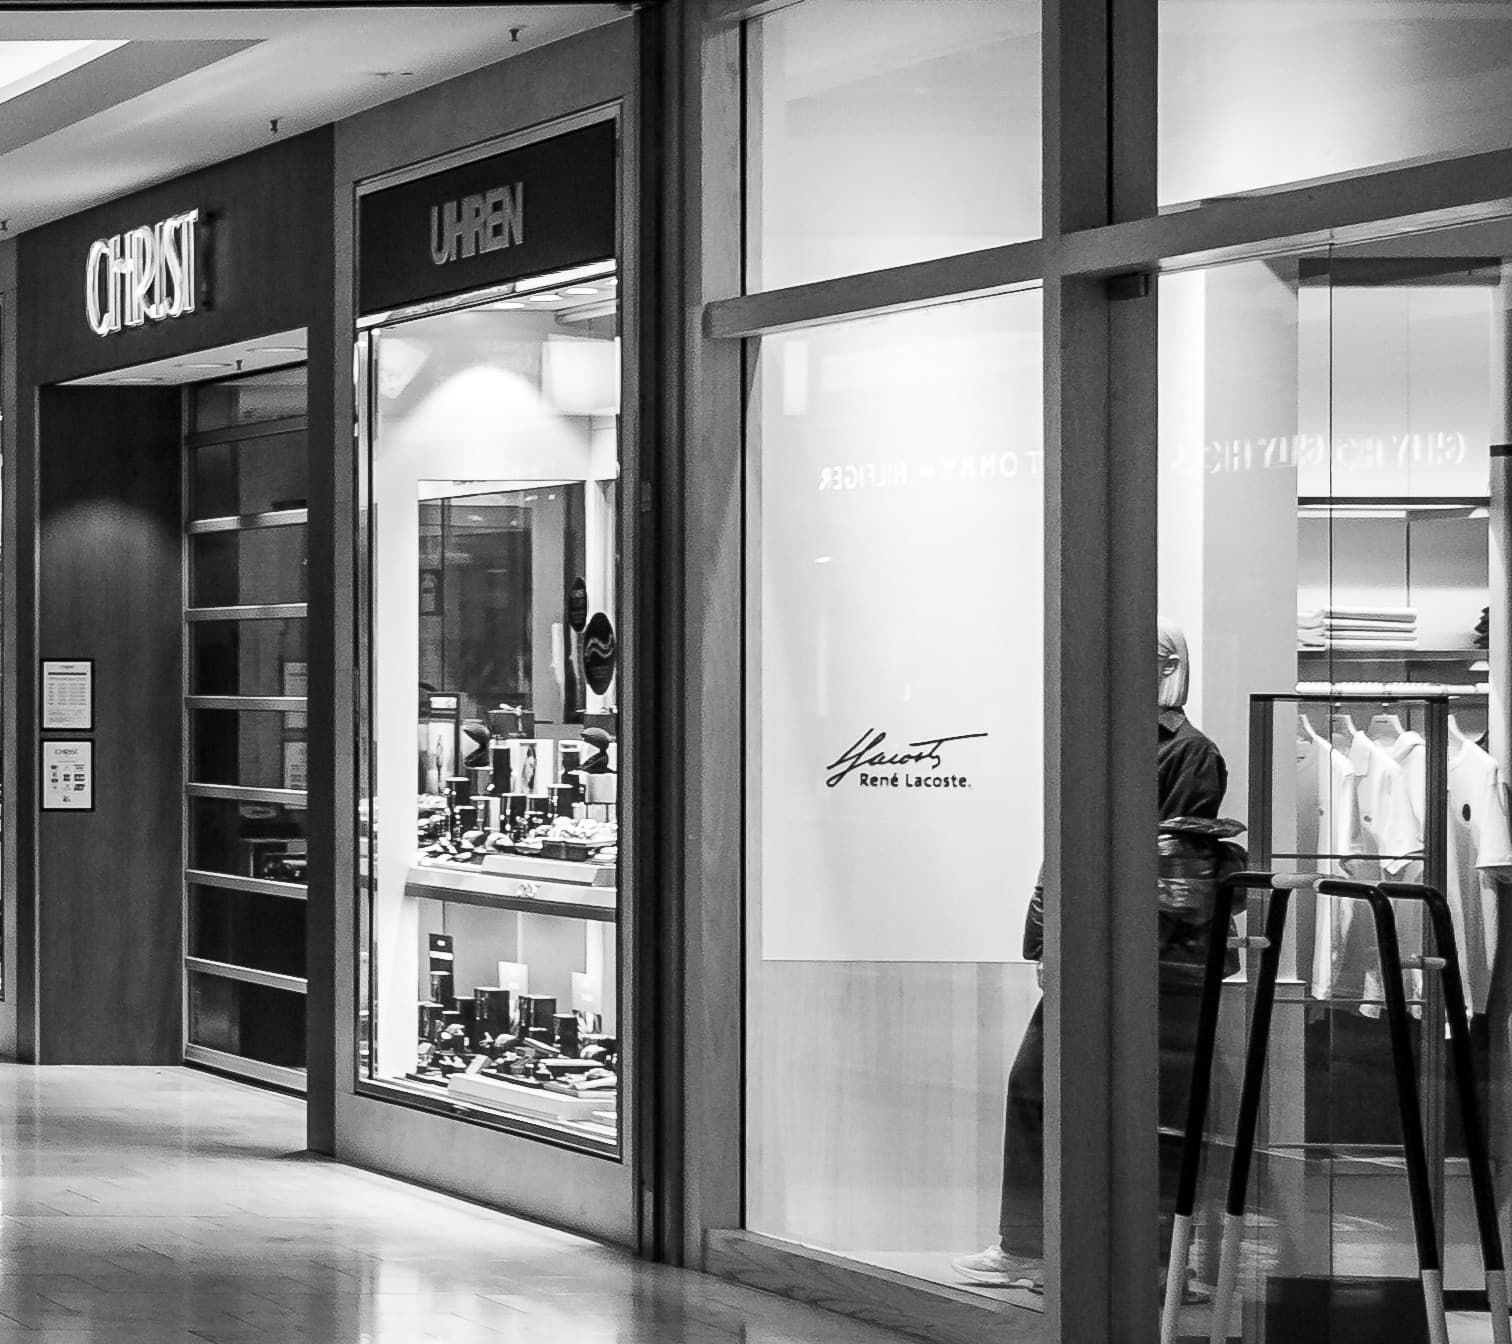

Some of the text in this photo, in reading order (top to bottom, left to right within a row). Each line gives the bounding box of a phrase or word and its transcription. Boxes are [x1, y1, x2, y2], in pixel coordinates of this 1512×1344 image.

[430, 181, 524, 265] UHREN
[86, 207, 199, 338] CHRIST
[859, 772, 899, 788] René
